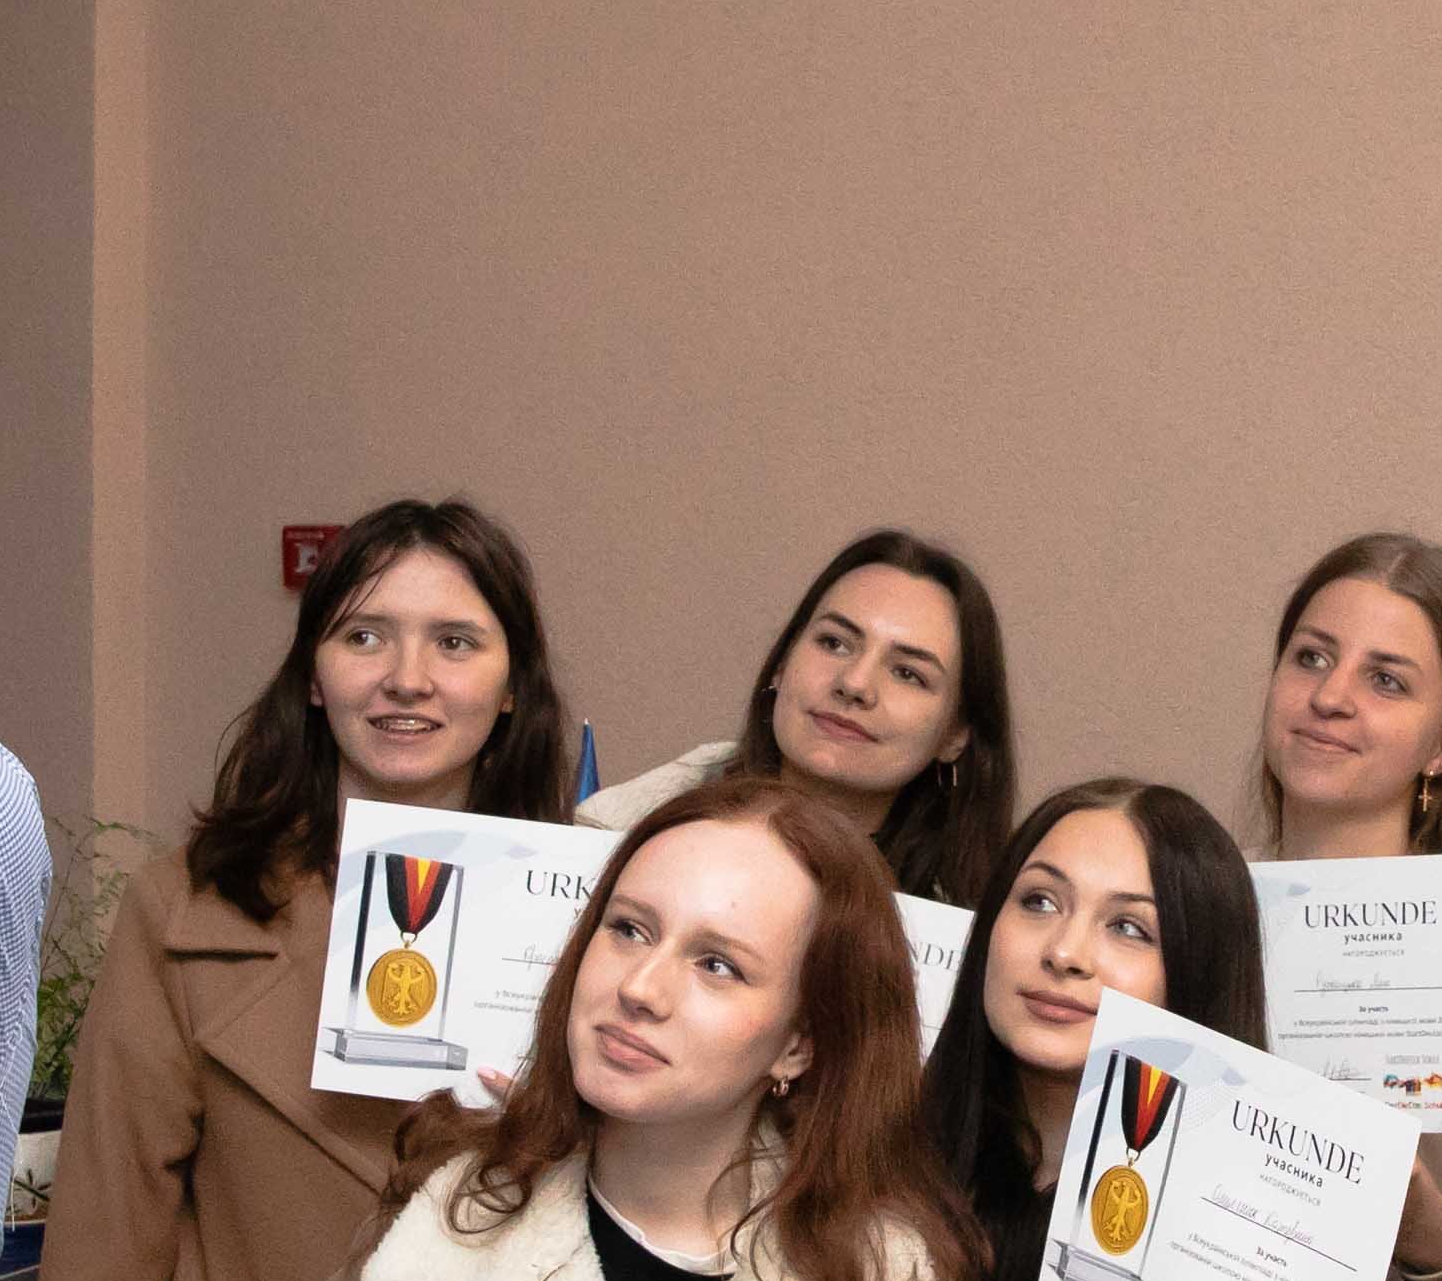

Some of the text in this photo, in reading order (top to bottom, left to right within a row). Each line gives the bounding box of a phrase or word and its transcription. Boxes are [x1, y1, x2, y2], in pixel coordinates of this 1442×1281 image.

[1304, 900, 1436, 928] URKUNDE
[1344, 932, 1402, 945] учасника
[1232, 1099, 1364, 1184] URKUNDE
[1264, 1153, 1322, 1187] учасника
